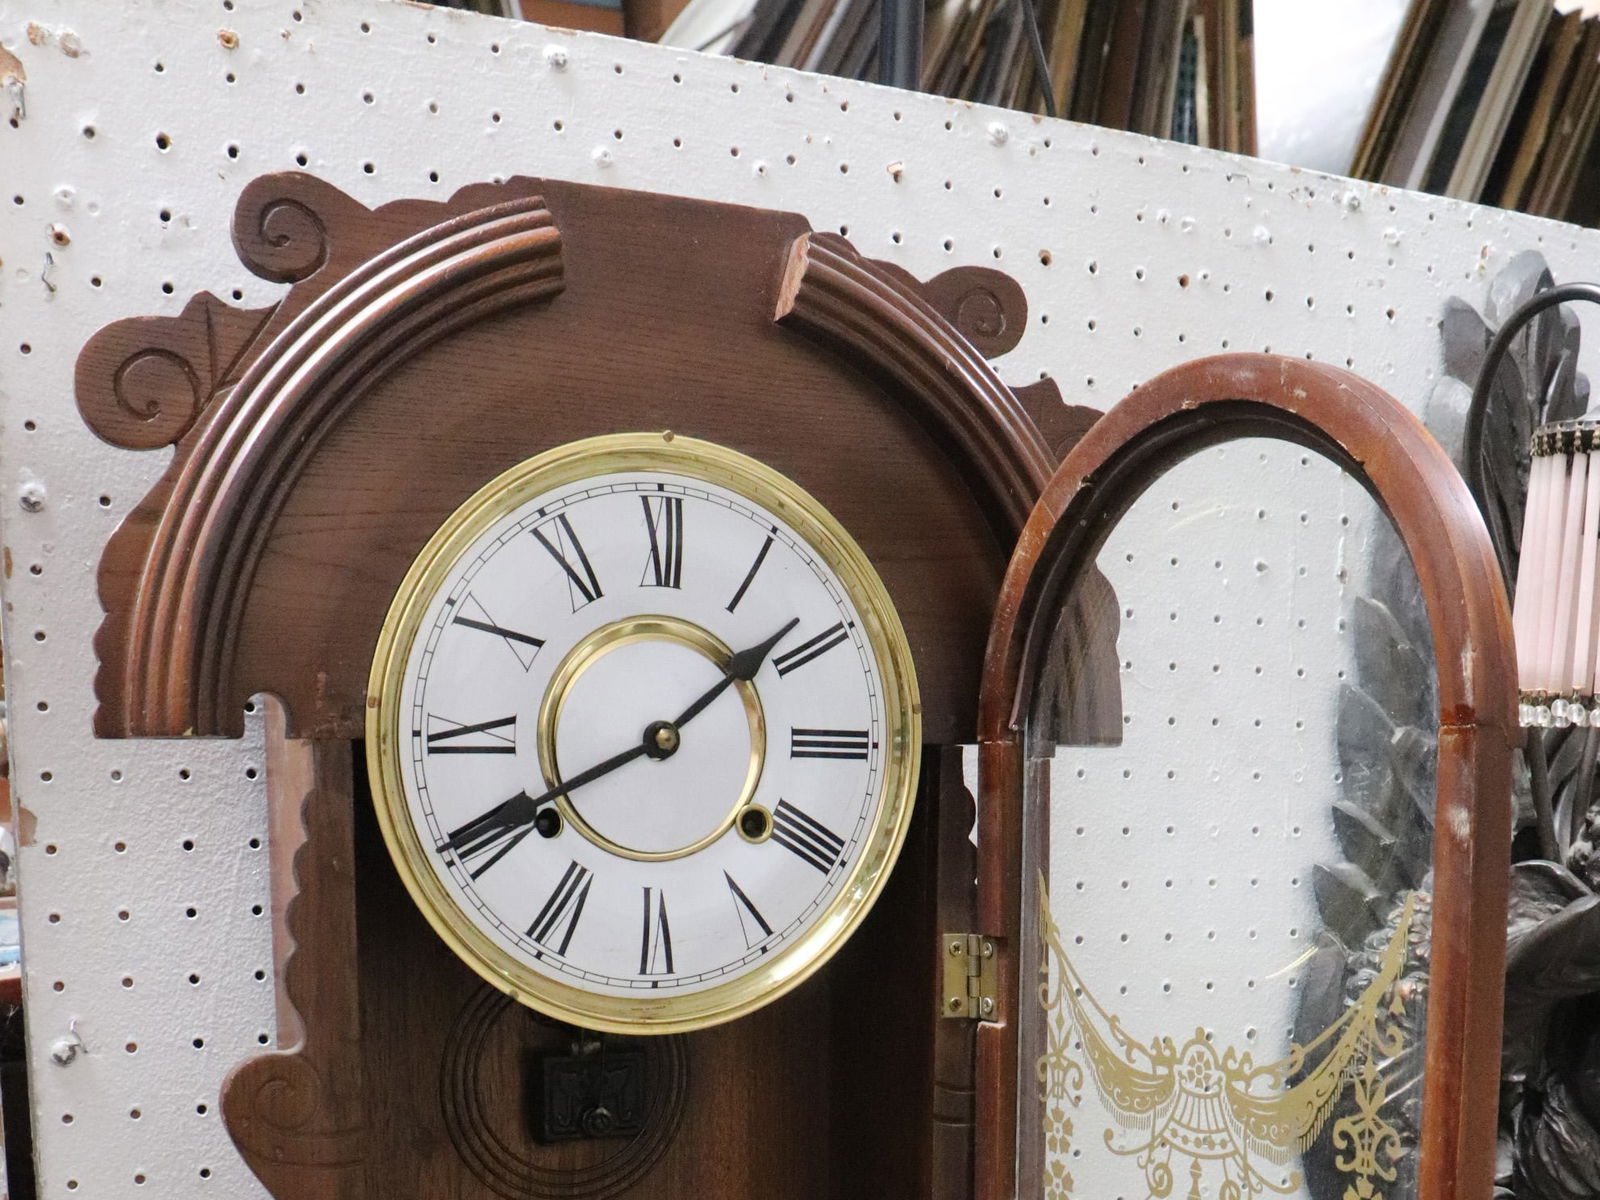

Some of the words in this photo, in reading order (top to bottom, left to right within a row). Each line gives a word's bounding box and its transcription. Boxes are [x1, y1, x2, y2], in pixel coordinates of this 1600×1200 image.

[532, 513, 604, 613] XI
[639, 495, 683, 589] XII
[726, 535, 775, 613] I
[453, 592, 547, 672] X
[773, 621, 849, 679] II
[427, 713, 517, 756] IX
[791, 727, 869, 761] III
[771, 797, 846, 876] IIII
[525, 860, 594, 957] VII
[638, 887, 676, 976] VI
[723, 869, 774, 950] V
